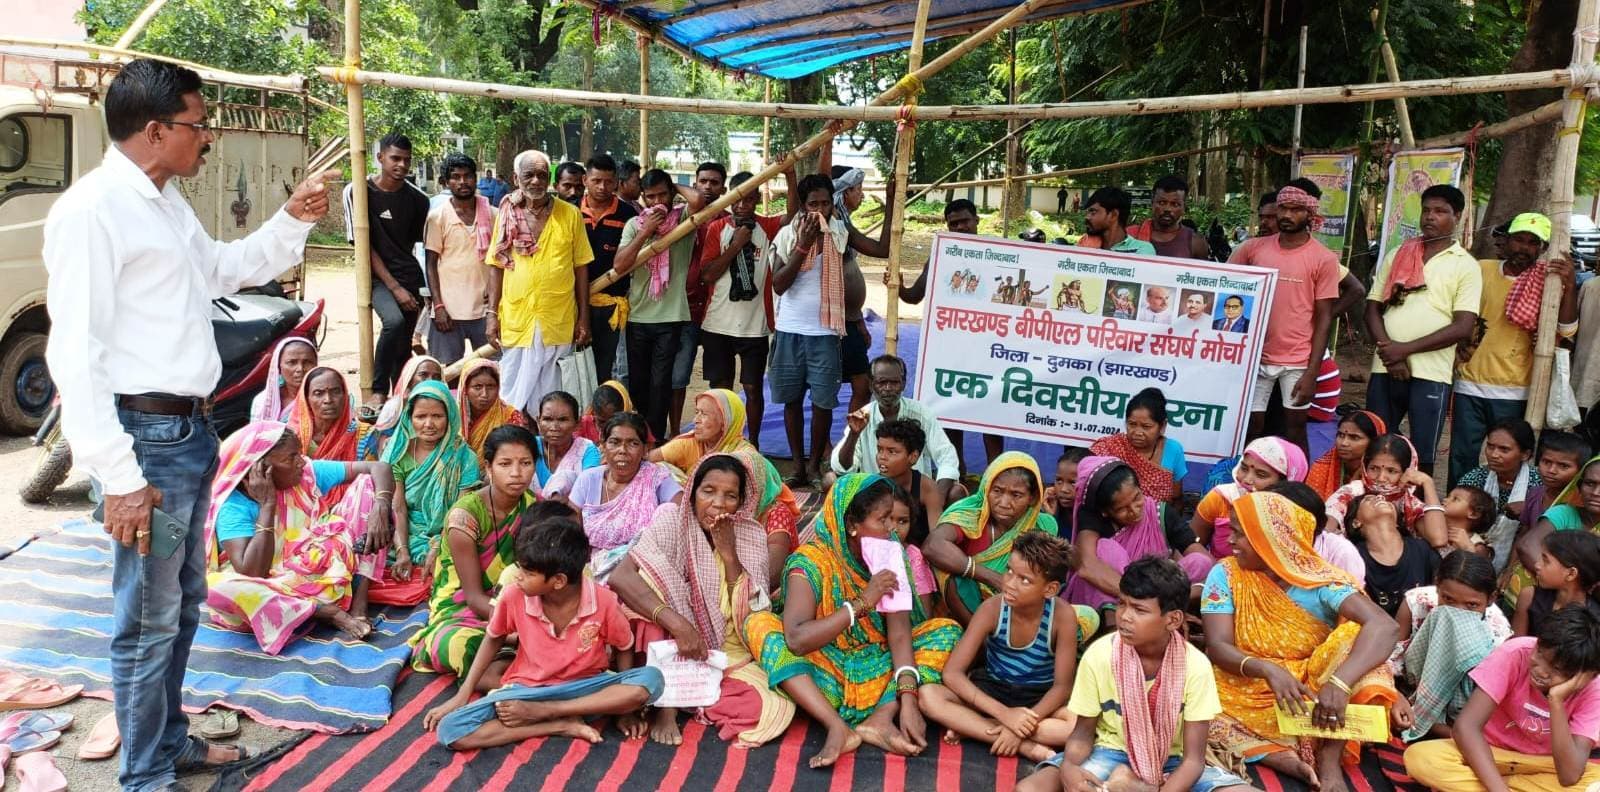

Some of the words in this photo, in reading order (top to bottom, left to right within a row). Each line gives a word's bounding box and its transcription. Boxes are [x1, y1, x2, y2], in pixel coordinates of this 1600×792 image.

[945, 244, 963, 257] गरीब
[964, 248, 983, 259] एकता
[985, 248, 1020, 264] जिन्दाबाद!
[1057, 257, 1076, 271] गरीब
[1077, 261, 1097, 273] एकता
[1098, 261, 1135, 278] जिन्दाबाद!
[1176, 272, 1195, 285] गरीब
[1197, 276, 1217, 288] एकता
[1219, 276, 1257, 292] जिन्दाबाद!
[936, 306, 1012, 338] झारखण्ड
[1015, 308, 1084, 345] बीपीएल
[1087, 318, 1148, 354] परिवार
[1150, 327, 1200, 359] संघर्ष
[1200, 333, 1248, 365] मोर्चा
[990, 343, 1029, 363] जिला
[1047, 354, 1093, 373] दुमका
[1098, 357, 1177, 385] (झारखण्ड)
[935, 368, 993, 399] एक
[1001, 367, 1130, 419] दिवसीय
[1166, 400, 1228, 431] रना
[1025, 412, 1057, 427] दिनांक
